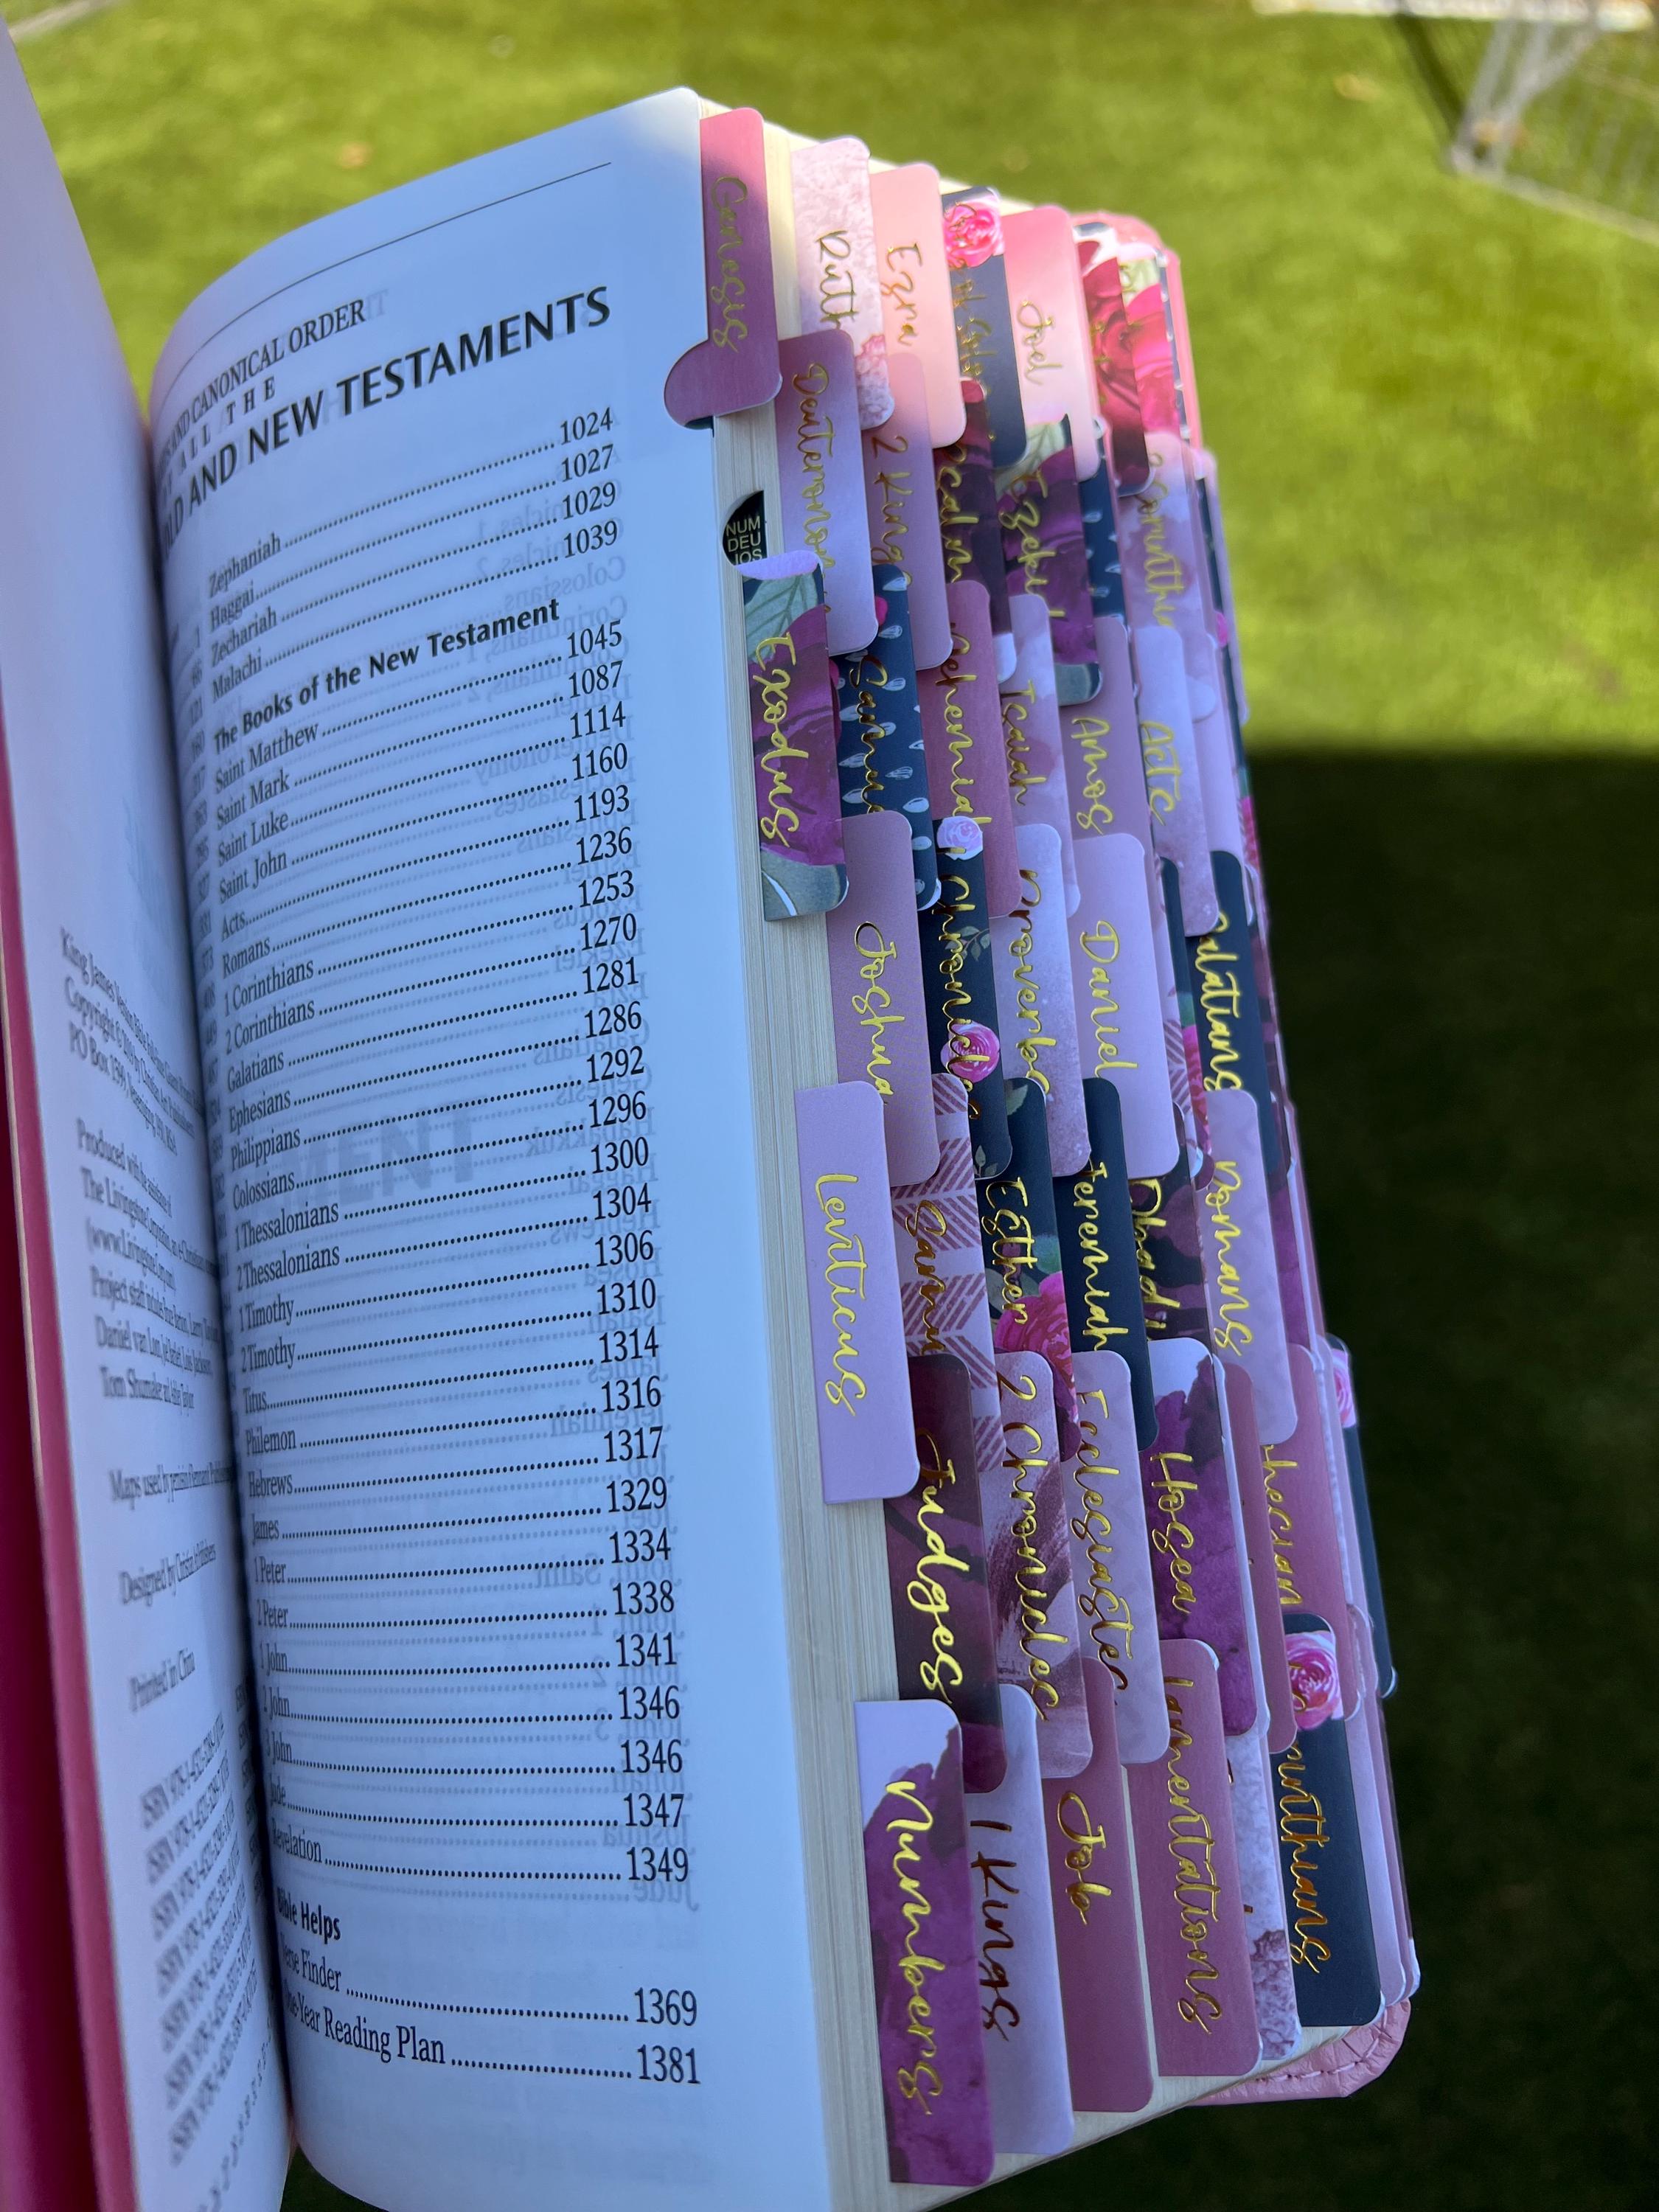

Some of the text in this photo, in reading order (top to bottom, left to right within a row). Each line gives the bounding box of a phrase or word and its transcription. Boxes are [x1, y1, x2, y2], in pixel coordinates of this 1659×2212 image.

[879, 241, 924, 346] Ezra
[1016, 298, 1063, 386] Joel
[188, 443, 238, 517] AND
[248, 389, 324, 466] NEW
[336, 285, 611, 417] TESTAMENTS
[191, 336, 285, 425] CANONICAL
[288, 299, 366, 354] ORDER
[226, 376, 276, 425] THE
[209, 407, 613, 599] Zephaniah 1024
[210, 443, 613, 633] Haggai 1027
[726, 515, 761, 537] NUM
[727, 532, 762, 553] DEU
[792, 363, 836, 613] Deuteronom
[869, 434, 915, 587] 2 King
[211, 481, 616, 667] Zechariah 1029
[212, 647, 262, 704] Malachi
[564, 520, 618, 559] 1039
[215, 725, 237, 755] The
[243, 693, 293, 735] Books
[299, 674, 319, 706] of
[325, 667, 362, 695] the
[369, 645, 420, 679] New
[427, 598, 560, 658] Testament
[215, 757, 245, 795] Saint
[248, 723, 319, 771] Matthew
[567, 619, 623, 658] 1045
[753, 632, 809, 848] Exodus
[849, 652, 888, 814] Samue
[216, 795, 246, 832] Saint
[249, 768, 291, 810] Mark
[568, 660, 624, 699] 1087
[218, 830, 248, 869] Saint
[251, 812, 289, 846] Luke
[570, 700, 627, 740] 1114
[1071, 716, 1114, 836] Amos
[1139, 720, 1183, 827] Acts
[220, 869, 248, 905] Saint
[252, 851, 288, 889] John
[572, 742, 628, 782] 1160
[221, 912, 246, 943] Acts
[574, 785, 630, 824] 1193
[223, 936, 271, 980] Romans
[577, 826, 632, 866] 1236
[224, 992, 230, 1018] 1
[233, 959, 315, 1011] Corinthians
[578, 869, 634, 908] 1253
[225, 1029, 232, 1056] 2
[234, 999, 316, 1050] Corinthians
[580, 913, 637, 951] 1270
[227, 1050, 285, 1094] Galatians
[582, 956, 639, 995] 1281
[852, 919, 906, 1102] Joshua
[1079, 919, 1138, 1079] Daniel
[229, 1089, 291, 1136] Ephesians
[584, 1000, 641, 1039] 1286
[231, 1046, 645, 1172] Philippians 1292
[232, 1091, 647, 1211] Colossians 1296
[234, 1225, 241, 1251] 1
[242, 1201, 339, 1249] Thessalonians
[591, 1136, 650, 1174] 1300
[236, 1265, 243, 1291] 2
[243, 1244, 340, 1290] Thessalonians
[593, 1183, 652, 1221] 1304
[239, 1307, 244, 1332] 1
[245, 1293, 294, 1332] Timothy
[594, 1230, 655, 1267] 1306
[814, 1173, 868, 1416] Leviticus
[981, 1175, 1039, 1325] Esther
[1205, 1161, 1253, 1357] Romans
[240, 1348, 247, 1373] 2
[247, 1336, 296, 1372] Timothy
[597, 1278, 657, 1315] 1310
[243, 1326, 659, 1416] Titus 1314
[996, 1374, 1038, 1402] 2
[246, 1375, 661, 1457] Philemon 1316
[248, 1470, 293, 1498] Hebrews
[604, 1425, 663, 1463] 1317
[251, 1475, 668, 1545] James 1329
[259, 1556, 287, 1585] Peter
[609, 1527, 672, 1564] 1334
[906, 1427, 971, 1705] Judges
[1150, 1452, 1198, 1615] Hosea
[262, 1599, 289, 1628] Peter
[612, 1579, 675, 1615] 1338
[265, 1643, 288, 1676] John
[615, 1632, 678, 1668] 1341
[269, 1686, 291, 1720] John
[618, 1685, 681, 1720] 1346
[272, 1731, 293, 1764] John
[620, 1739, 683, 1774] 1346
[623, 1792, 684, 1829] 1347
[626, 1846, 689, 1882] 1349
[1056, 1790, 1113, 1926] Job
[301, 1901, 341, 1944] Helps
[301, 1948, 341, 1992] Finder
[634, 1987, 698, 2027] 1369
[886, 1780, 945, 2116] Numbers
[970, 1851, 1020, 2042] Kings
[323, 2006, 392, 2063] Reading
[396, 2025, 446, 2065] Plan
[637, 2044, 700, 2084] 1381
